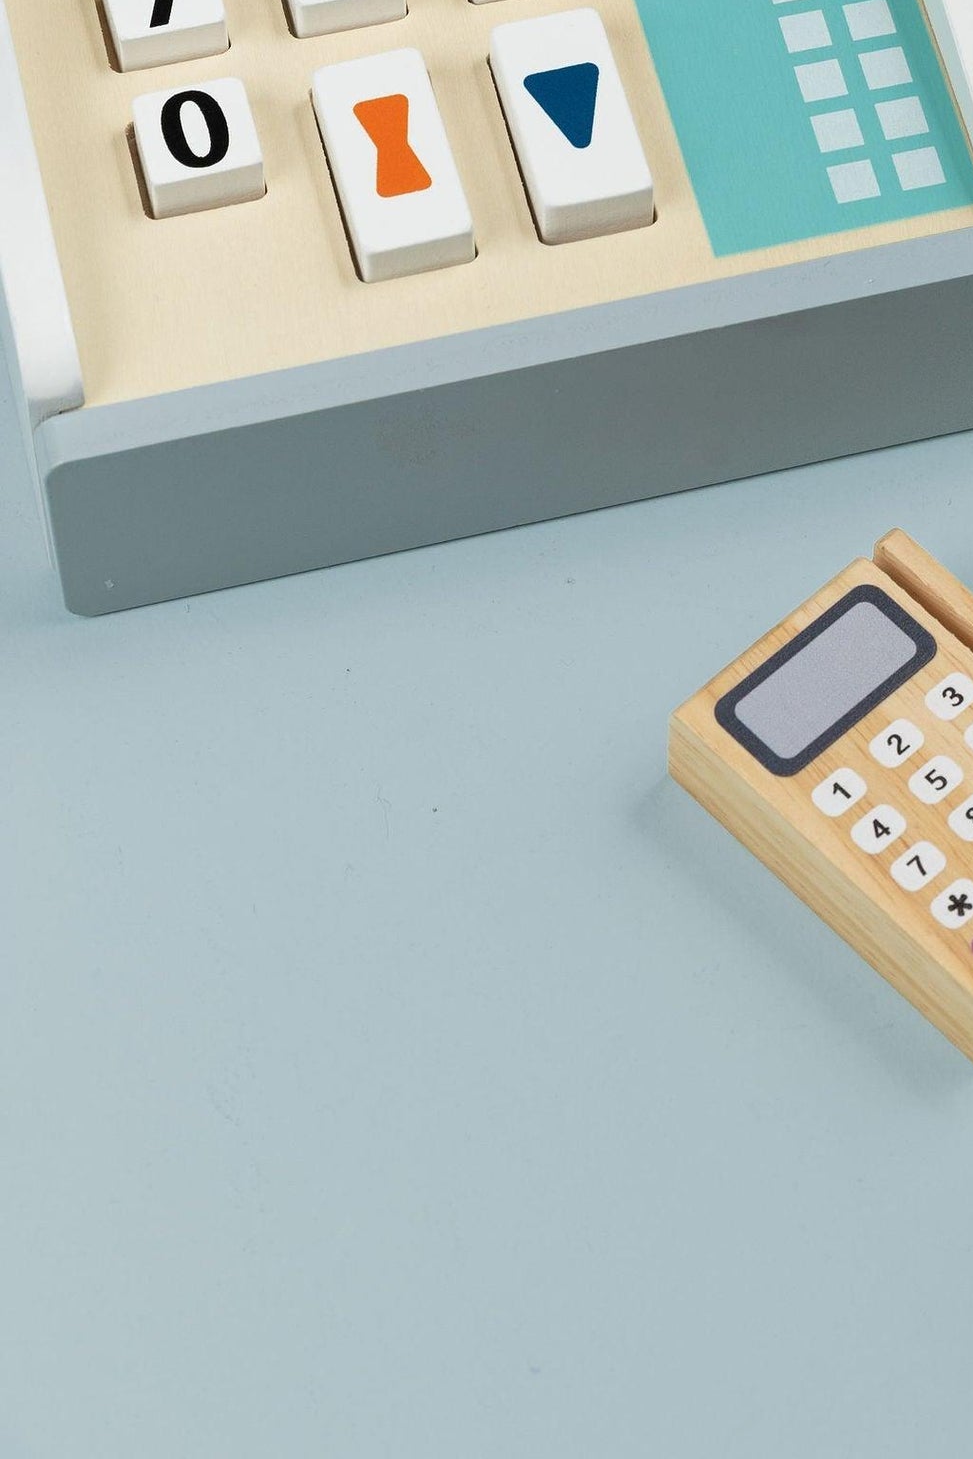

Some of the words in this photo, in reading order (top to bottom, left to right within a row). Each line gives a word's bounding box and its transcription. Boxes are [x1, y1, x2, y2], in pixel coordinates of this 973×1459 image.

[160, 90, 230, 168] 0
[832, 782, 853, 801] 1
[886, 733, 912, 756] 2
[941, 686, 965, 708] 3
[871, 818, 892, 839] 4
[924, 768, 949, 791] 5
[906, 854, 929, 878] 7
